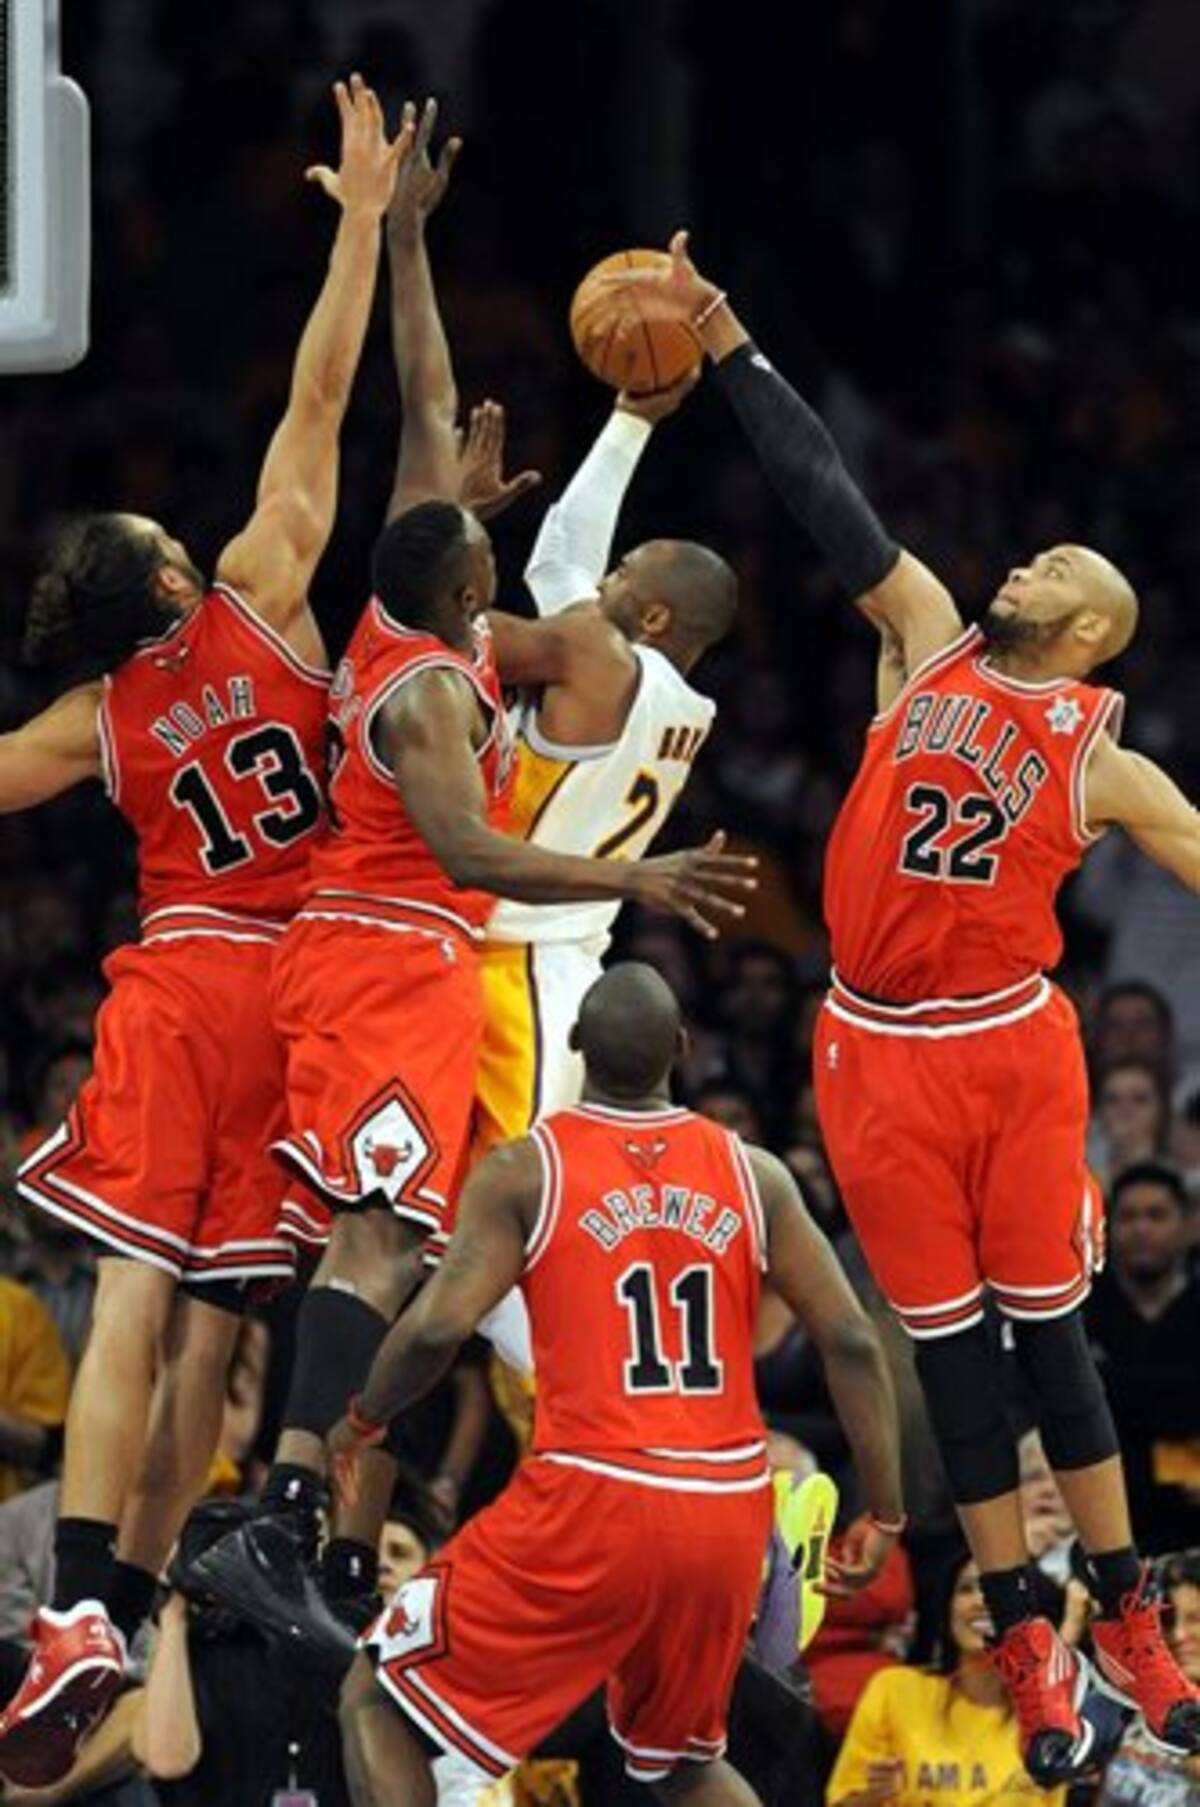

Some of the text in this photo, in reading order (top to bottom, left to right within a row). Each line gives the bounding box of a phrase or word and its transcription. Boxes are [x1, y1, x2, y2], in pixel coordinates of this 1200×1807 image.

[149, 675, 257, 759] NOAH
[893, 691, 1049, 827] BULLS
[168, 721, 324, 876] 13
[589, 768, 661, 859] 2
[898, 782, 1010, 885] 22
[578, 1182, 743, 1255] BREWER
[615, 1260, 724, 1398] 11
